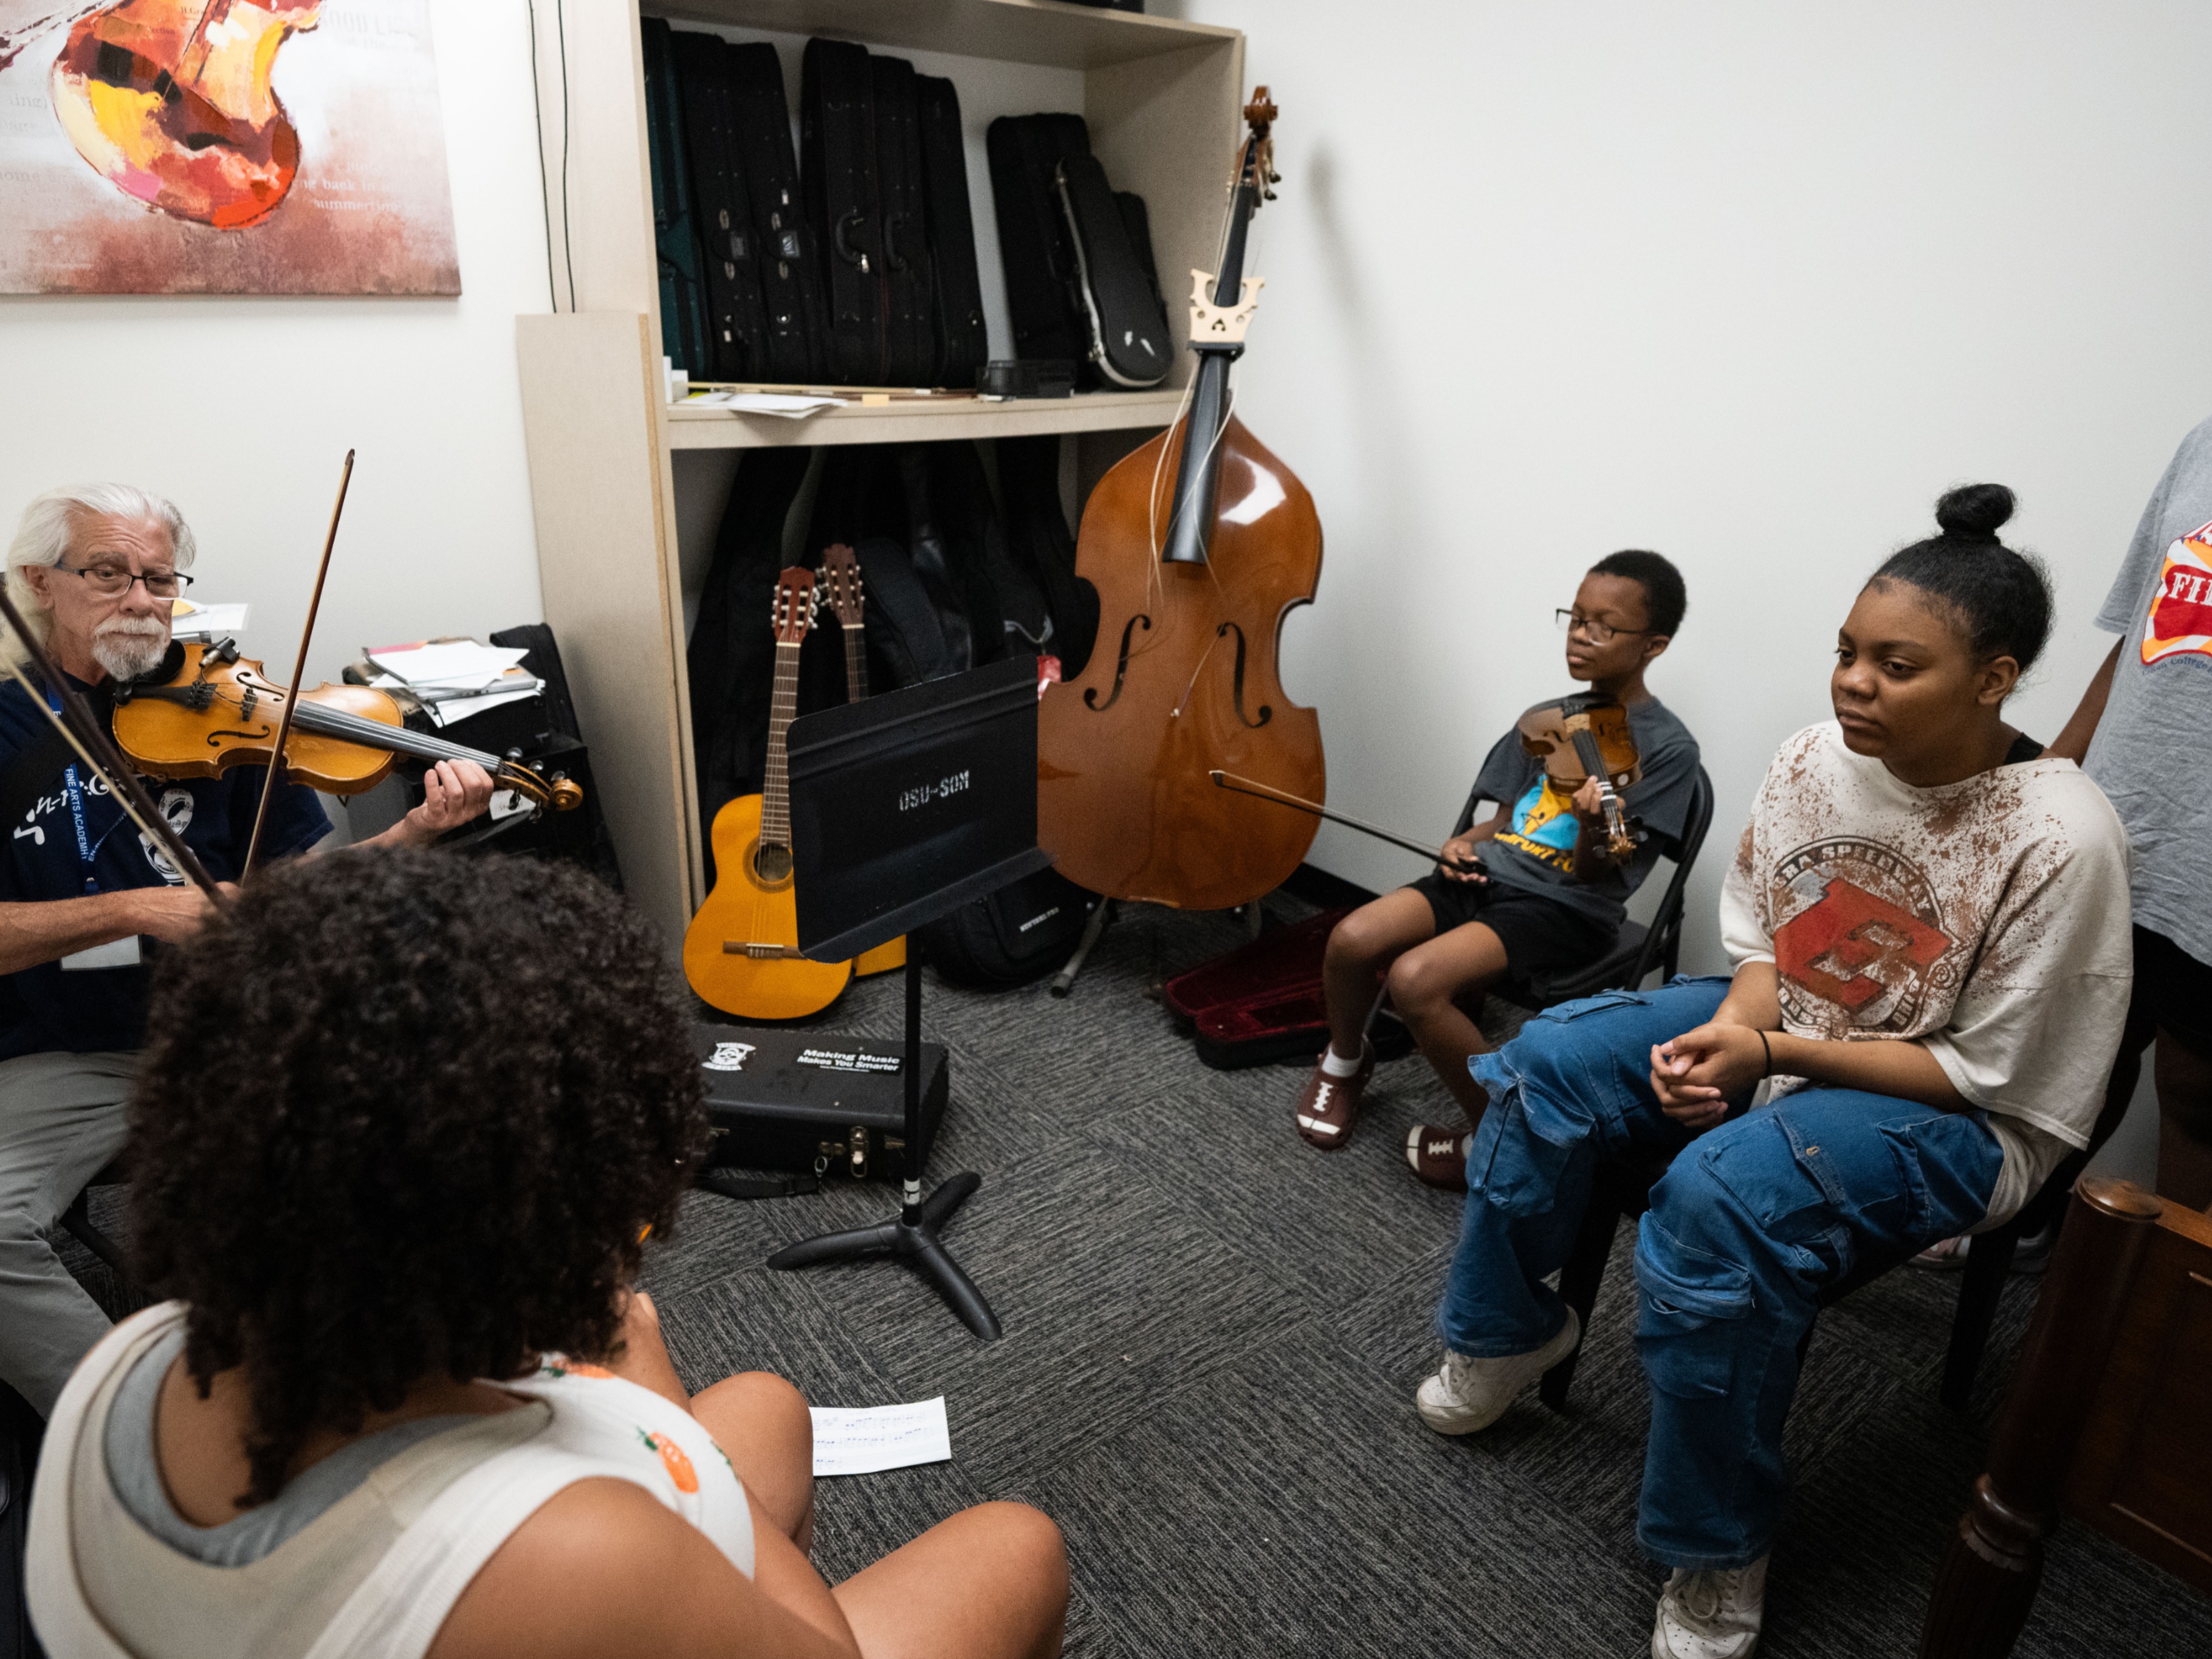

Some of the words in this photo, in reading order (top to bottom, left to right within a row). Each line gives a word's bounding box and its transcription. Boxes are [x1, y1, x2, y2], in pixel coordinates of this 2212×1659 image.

[65, 768, 77, 787] FINE
[69, 789, 81, 811] ARTS
[797, 1056, 833, 1065] Makes
[855, 1061, 899, 1071] Smarter
[803, 1049, 856, 1062] Making
[858, 1054, 900, 1064] Music
